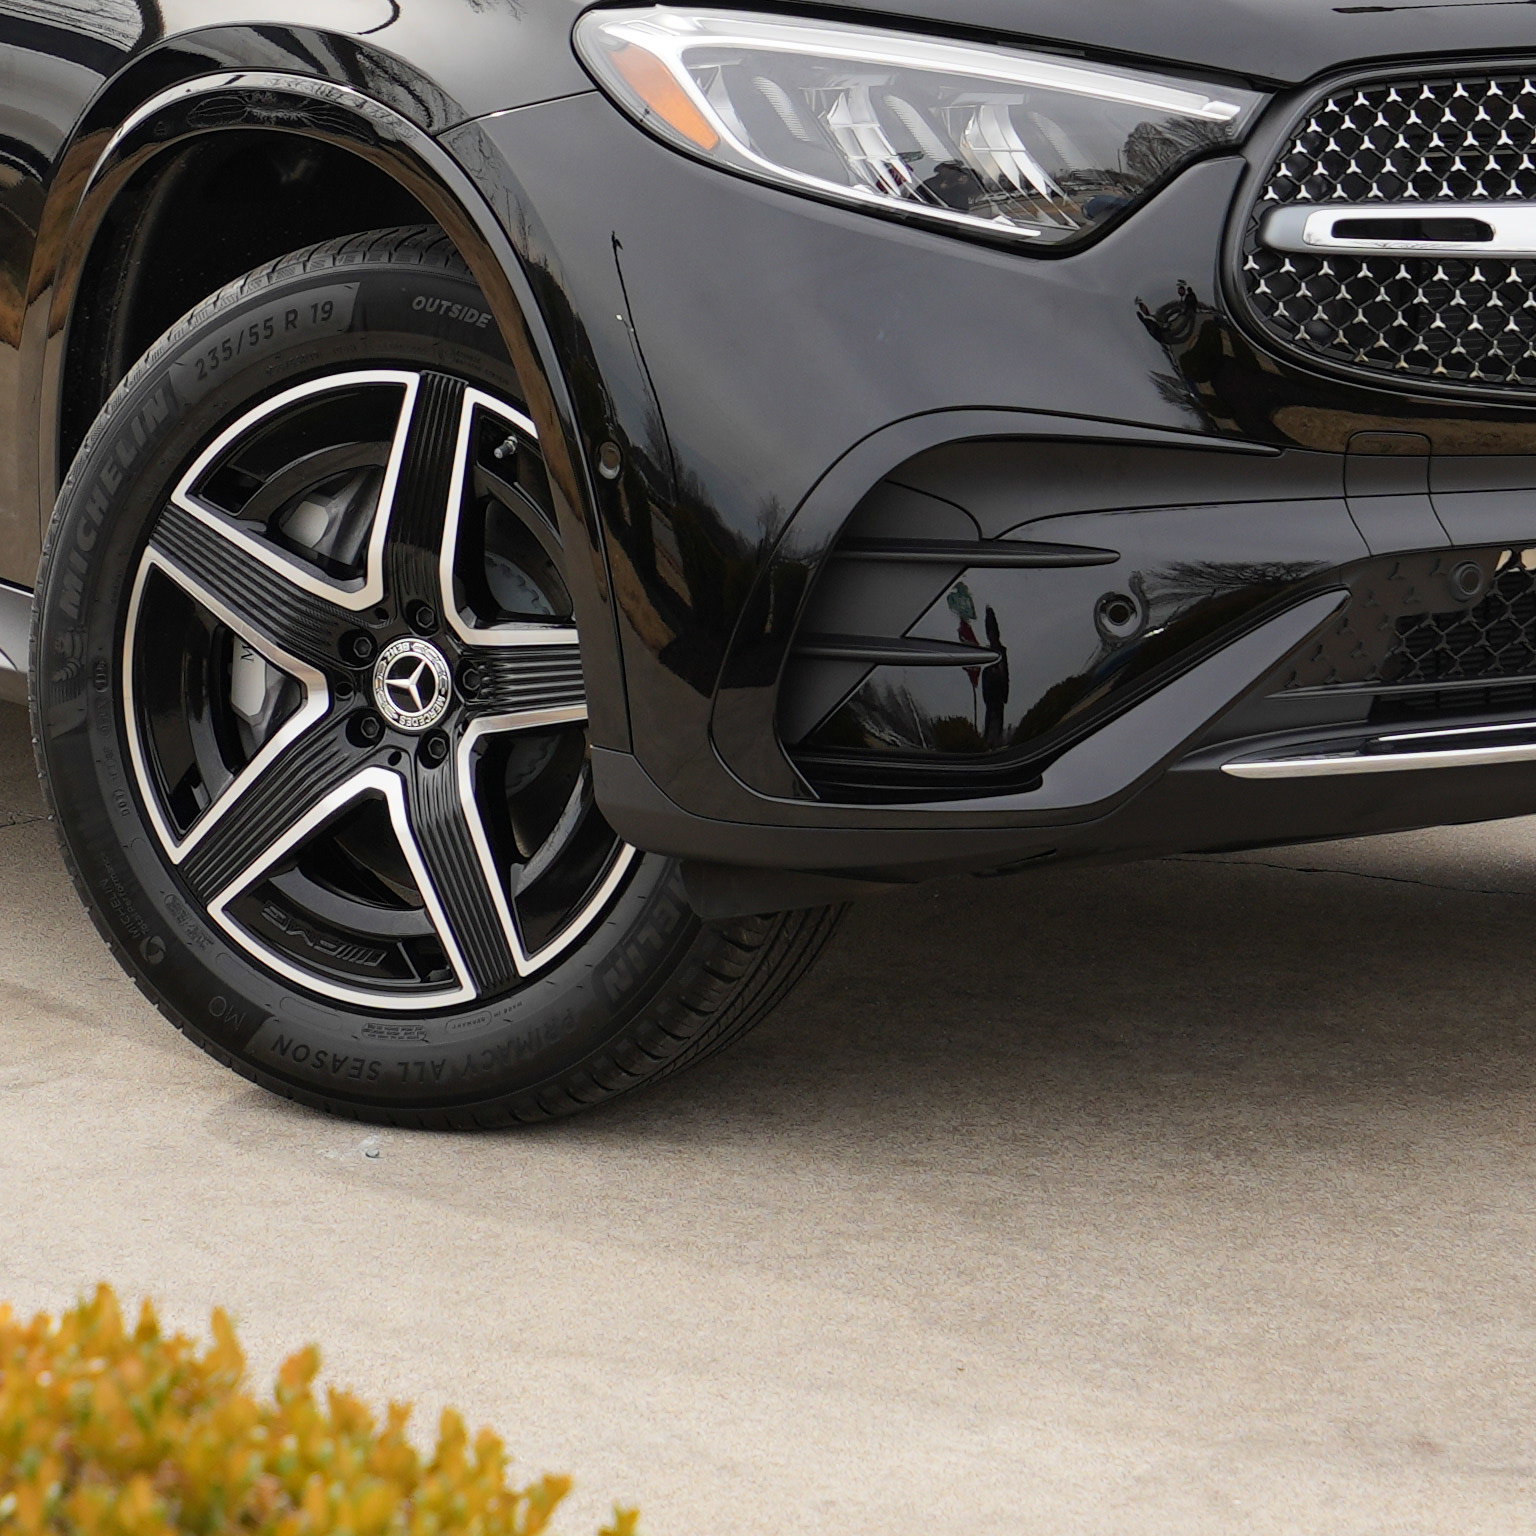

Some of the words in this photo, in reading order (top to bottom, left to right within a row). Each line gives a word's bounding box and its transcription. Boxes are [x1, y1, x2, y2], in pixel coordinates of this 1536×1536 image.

[411, 295, 494, 329] OUTSIDE
[196, 316, 274, 381] 235/55
[284, 308, 300, 330] R
[310, 299, 334, 325] 19
[59, 387, 170, 620] MICHELIN
[398, 694, 447, 728] MERCEDES
[208, 994, 247, 1032] MO
[269, 1033, 382, 1083] SEASON
[463, 1007, 578, 1080] PRIMACY
[398, 1057, 449, 1085] ALL
